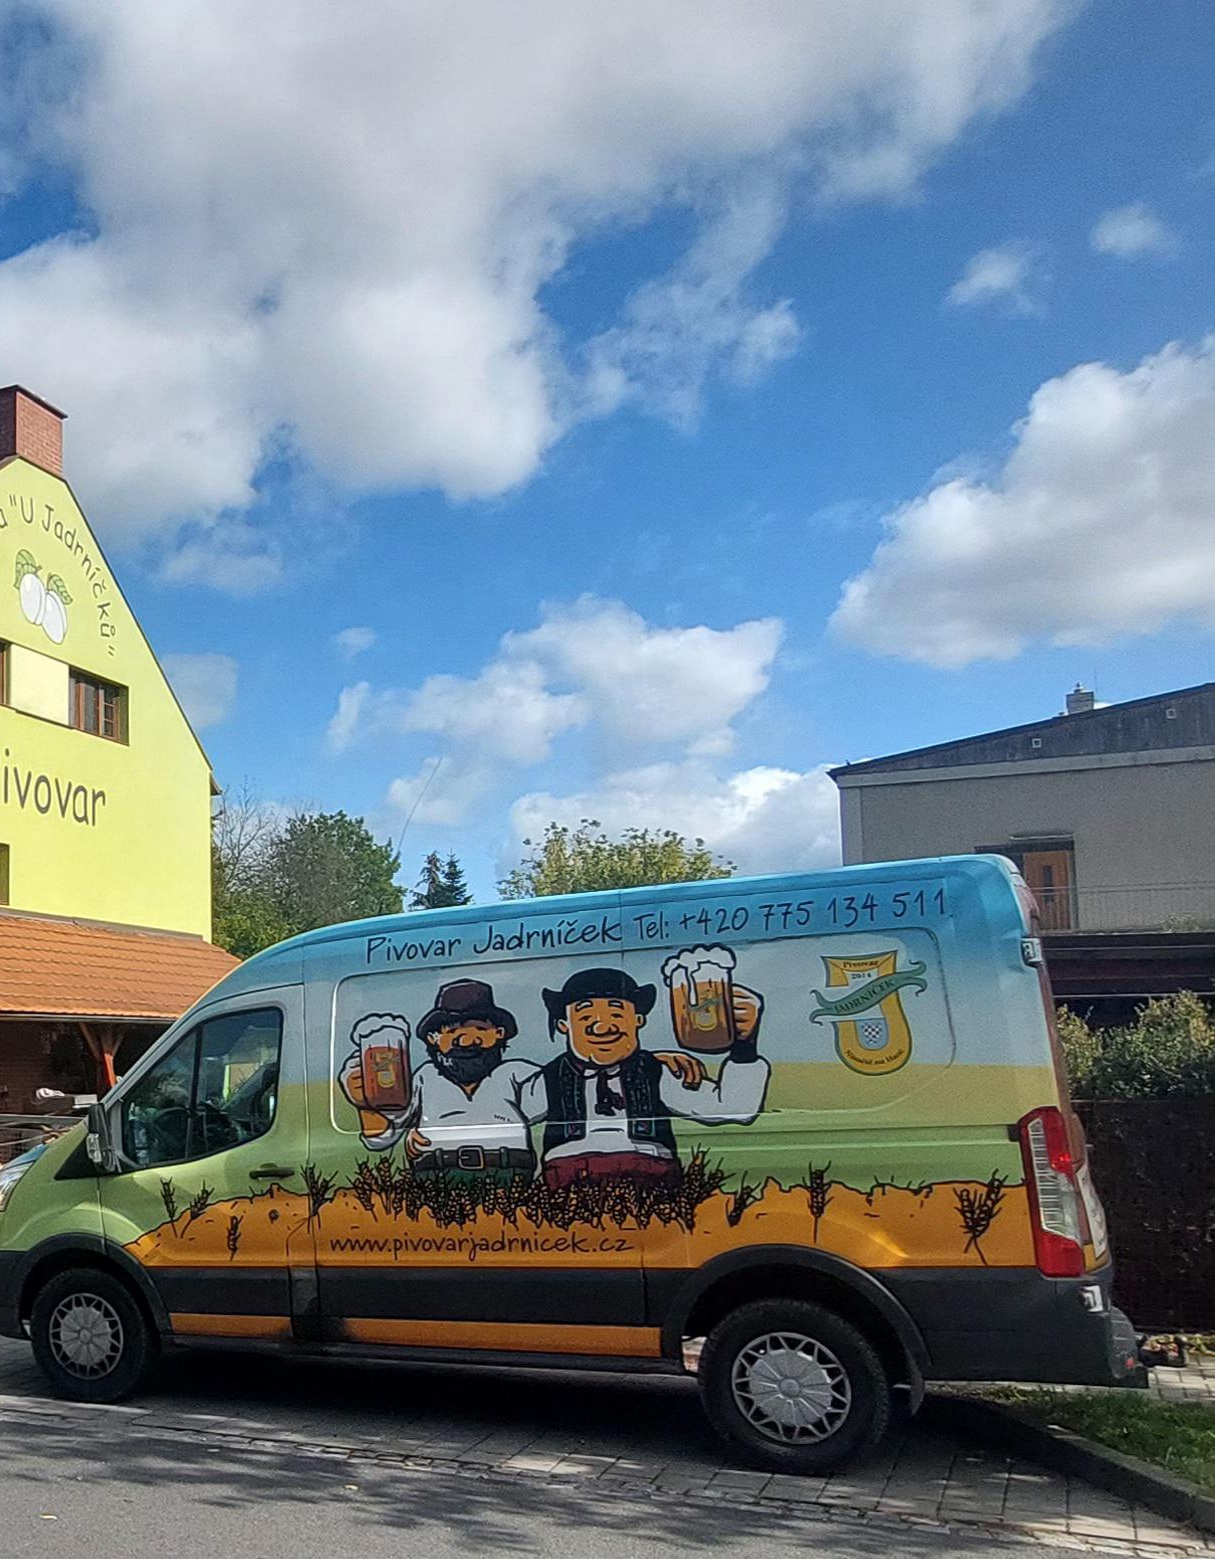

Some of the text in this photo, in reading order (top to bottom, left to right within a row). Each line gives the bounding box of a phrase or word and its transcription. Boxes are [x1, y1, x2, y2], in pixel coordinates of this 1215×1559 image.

[366, 887, 944, 964] Pivovar Jadrníček Tel: +420 775 134 511
[329, 1231, 635, 1261] www.pivovarjadrnicek.cz
